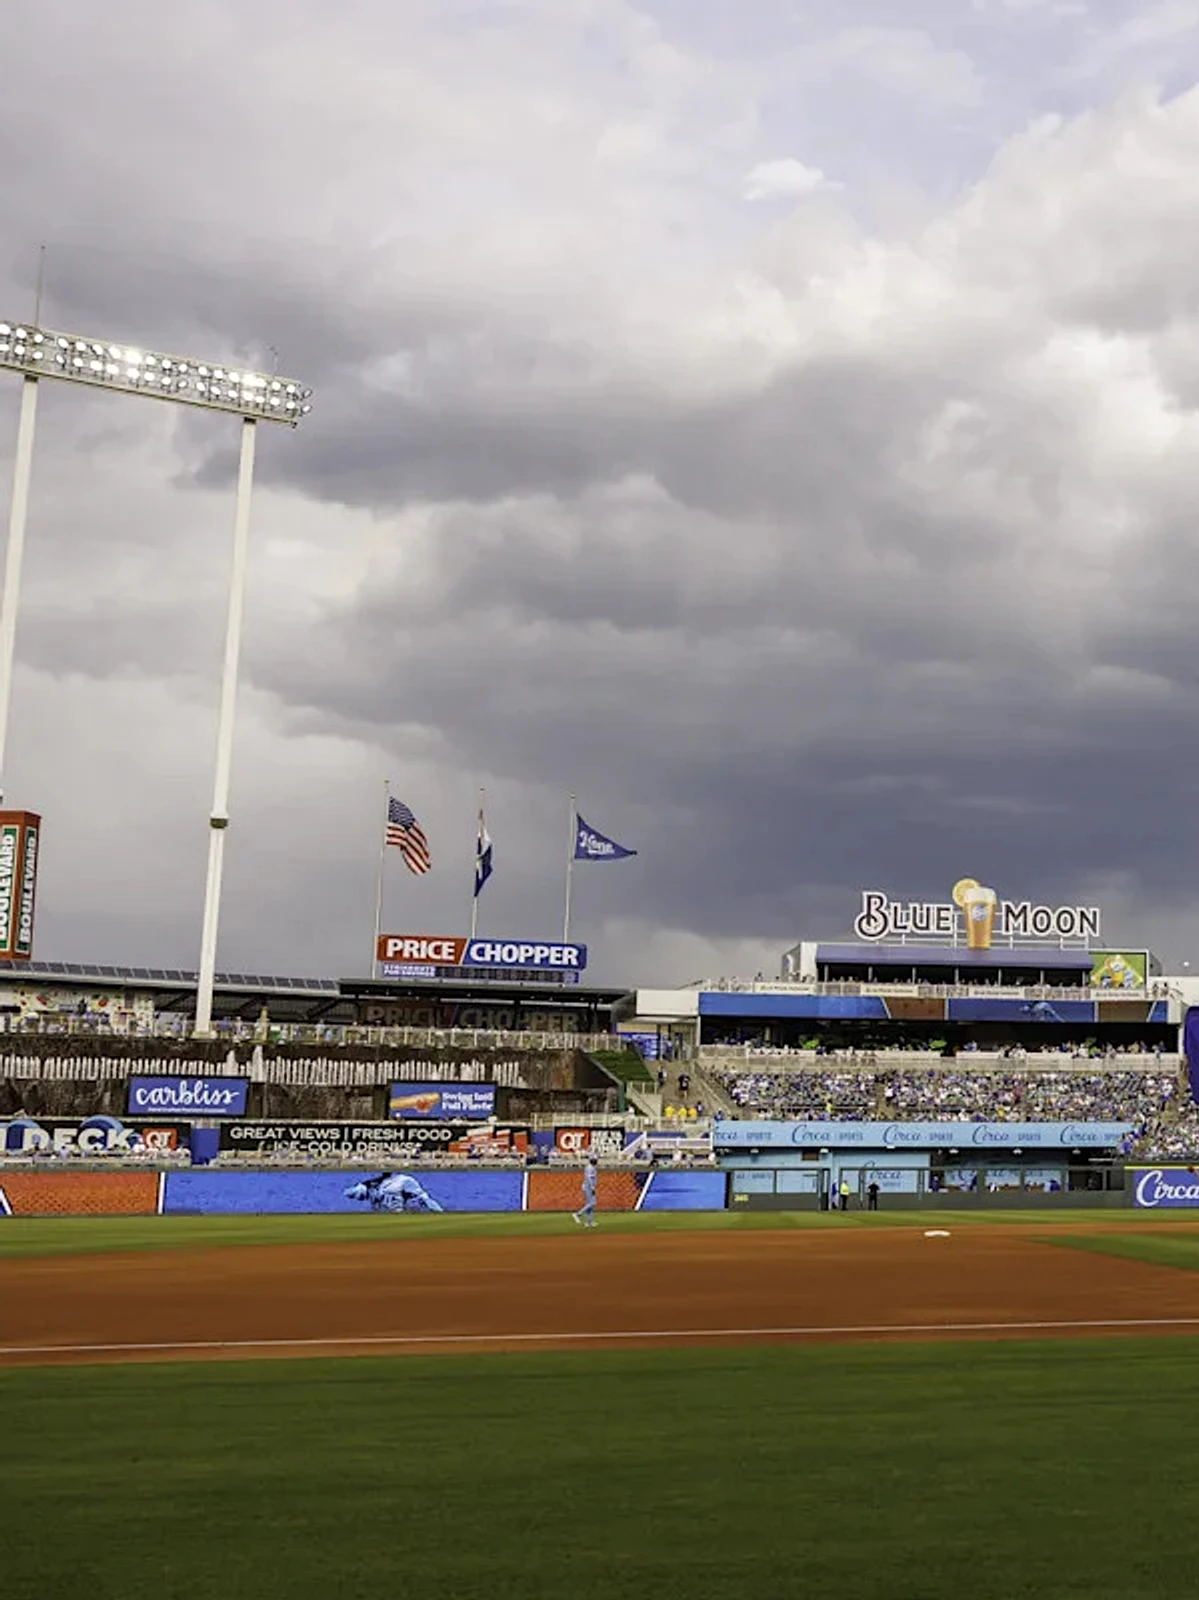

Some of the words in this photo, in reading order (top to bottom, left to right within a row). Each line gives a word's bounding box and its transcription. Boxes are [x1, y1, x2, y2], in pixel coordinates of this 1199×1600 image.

[19, 836, 36, 943] BOULEVARD
[1002, 901, 1100, 938] MOON
[386, 938, 456, 961] PRICE
[469, 941, 580, 966] CHOPPER
[136, 1080, 240, 1105] carbliss
[23, 1128, 134, 1150] DECK
[146, 1131, 171, 1150] QT
[230, 1127, 286, 1139] GREAT
[289, 1127, 341, 1140] VIEWS
[352, 1128, 404, 1141] FRESH
[408, 1129, 452, 1141] FOOD
[560, 1131, 585, 1150] QT
[792, 1124, 831, 1144] Circa
[883, 1124, 921, 1145] Circa
[972, 1124, 1009, 1145] Circa
[1060, 1124, 1097, 1145] Circa
